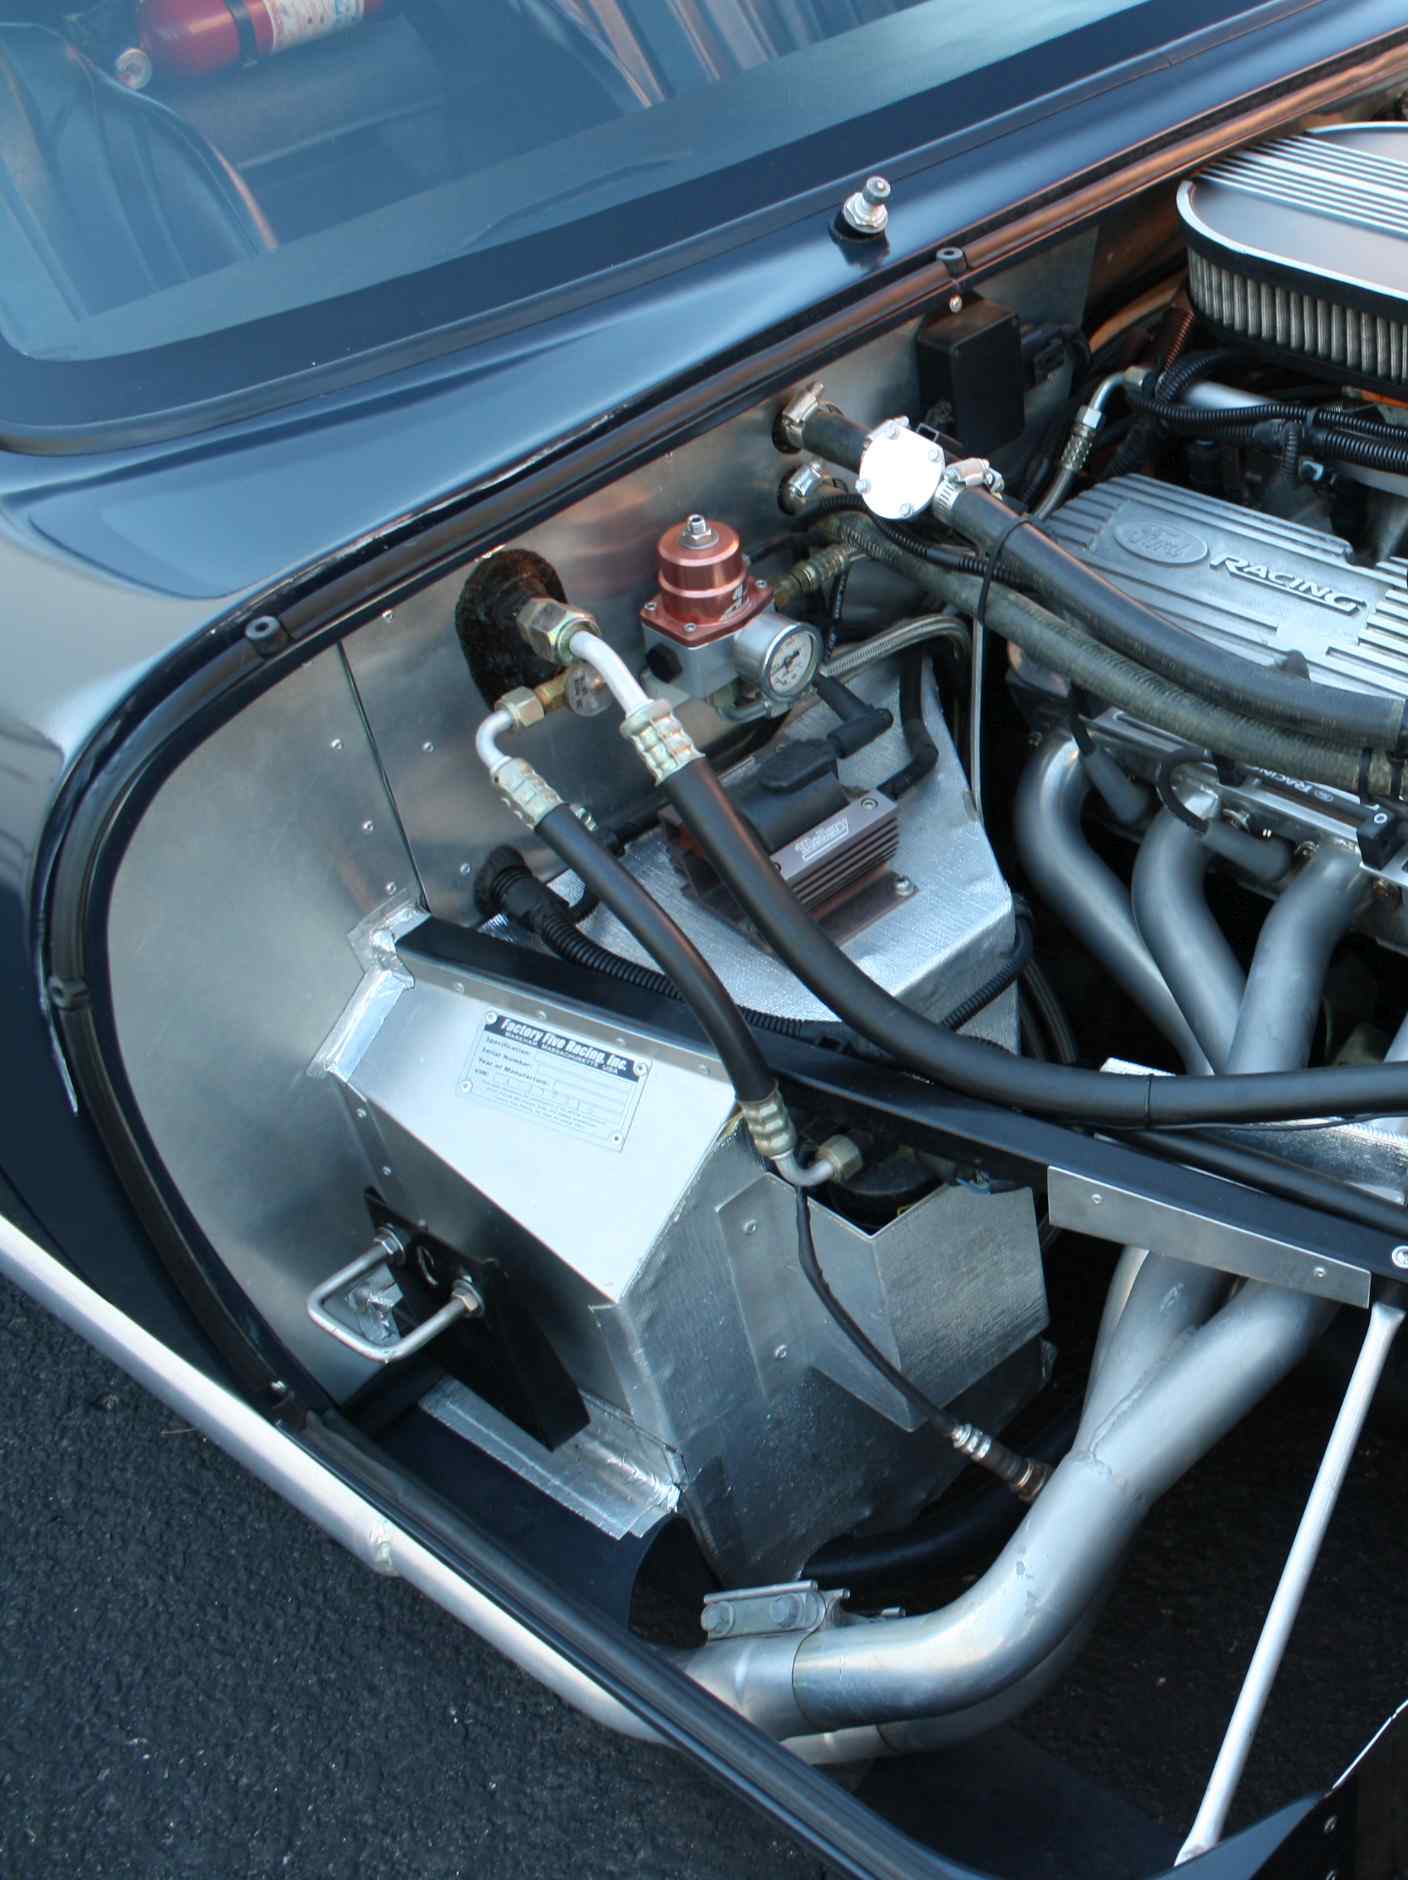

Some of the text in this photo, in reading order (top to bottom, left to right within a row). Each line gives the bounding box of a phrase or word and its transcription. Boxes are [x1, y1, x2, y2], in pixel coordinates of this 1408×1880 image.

[1128, 522, 1369, 615] Ford RACING
[500, 1017, 545, 1043] Factory
[542, 1032, 564, 1050] Five
[607, 1054, 628, 1071] Inc.
